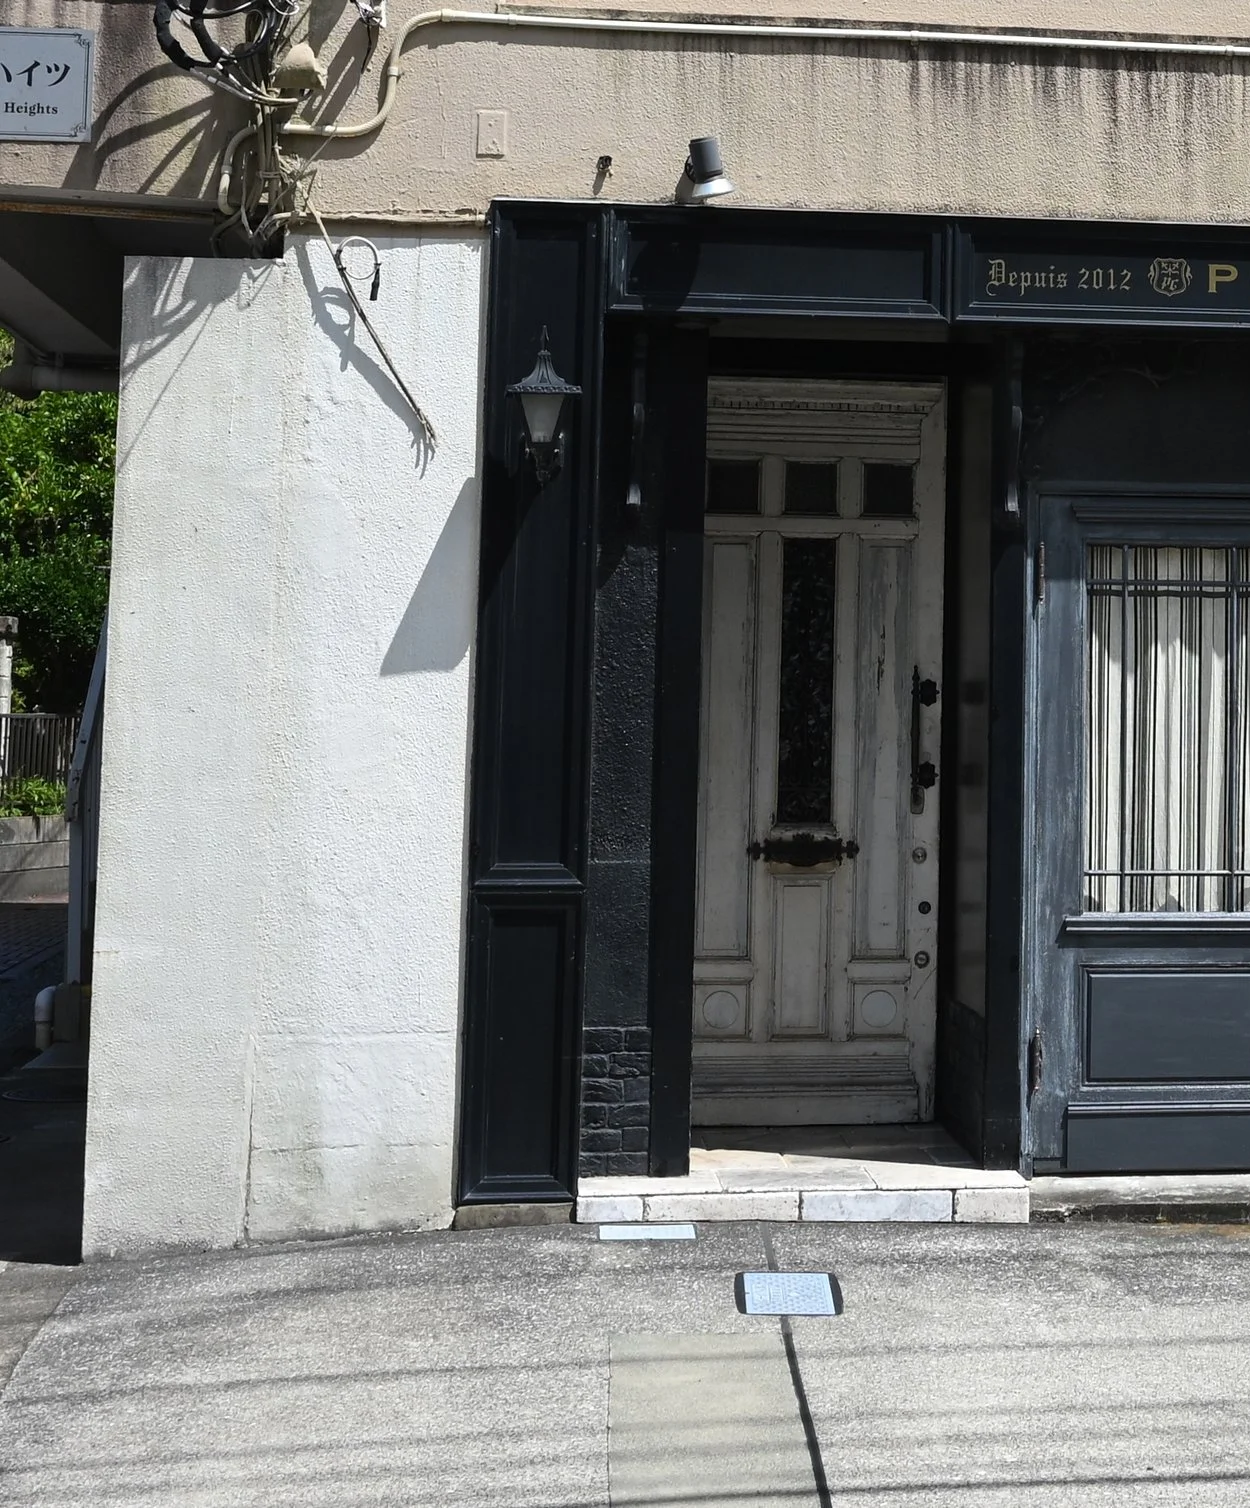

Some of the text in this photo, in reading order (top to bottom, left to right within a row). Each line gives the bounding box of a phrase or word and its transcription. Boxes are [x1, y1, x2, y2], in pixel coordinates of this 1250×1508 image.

[4, 101, 59, 116] Heights
[985, 258, 1068, 297] Depuis
[1078, 267, 1132, 291] 2012
